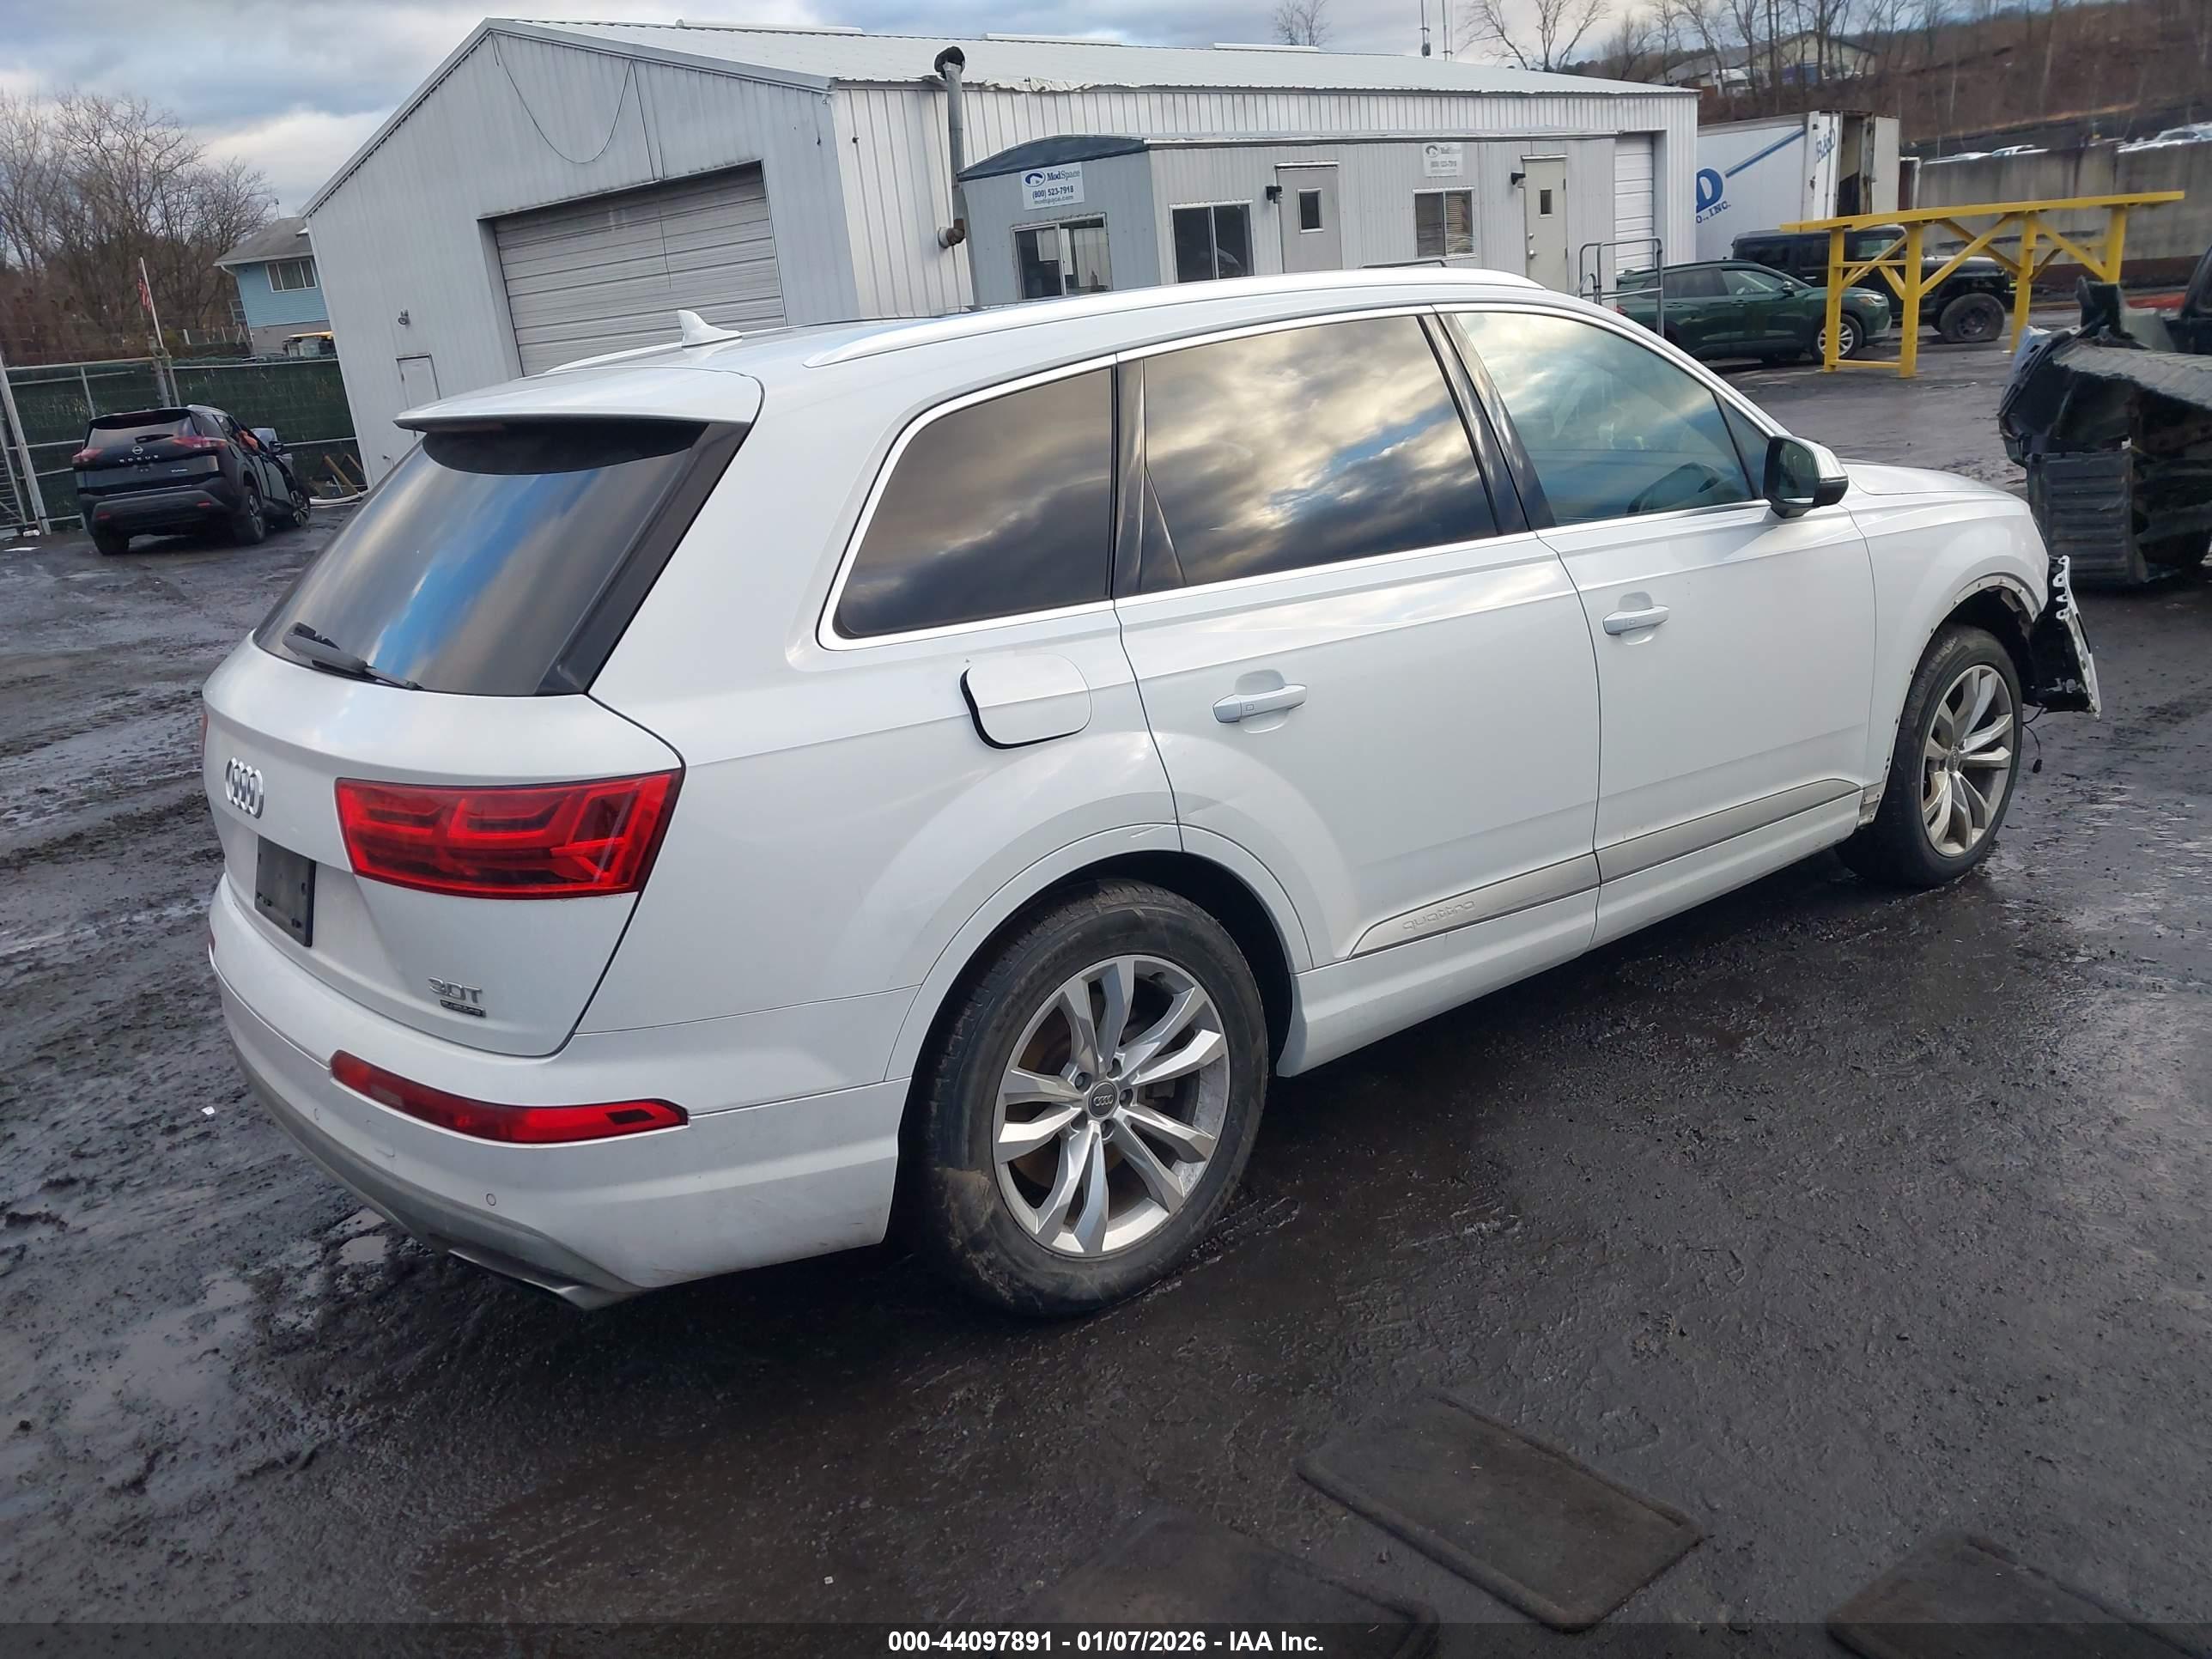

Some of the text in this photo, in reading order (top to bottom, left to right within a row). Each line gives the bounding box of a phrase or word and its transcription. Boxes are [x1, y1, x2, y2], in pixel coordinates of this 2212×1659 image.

[1047, 170, 1080, 181] ModSpace
[1033, 185, 1074, 199] (800) 523-7918
